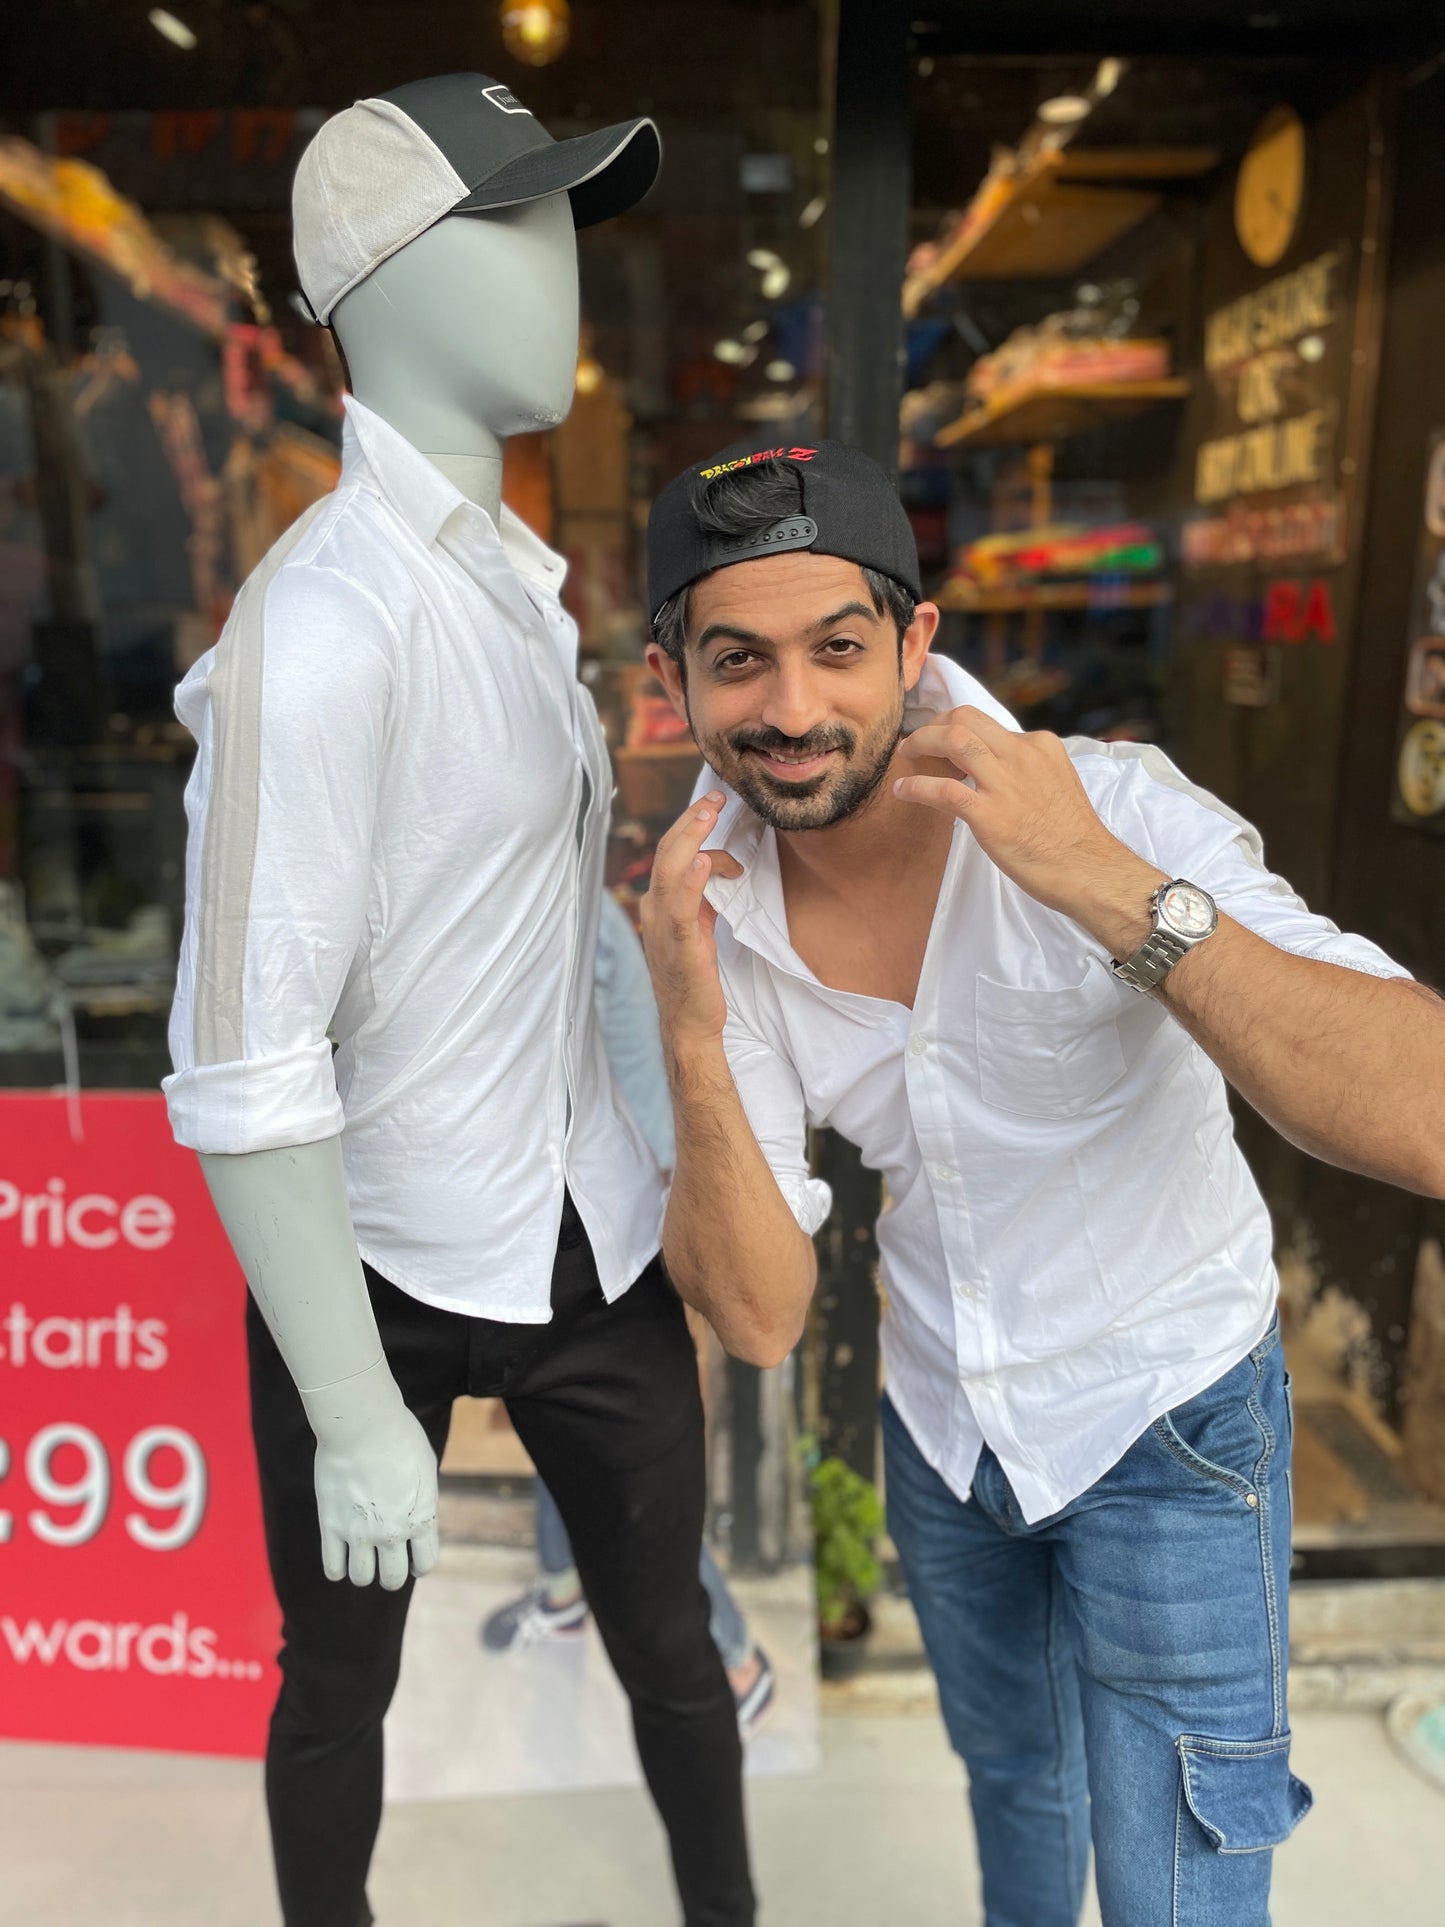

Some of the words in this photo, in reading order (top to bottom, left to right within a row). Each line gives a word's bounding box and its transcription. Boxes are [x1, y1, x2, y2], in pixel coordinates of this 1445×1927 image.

[787, 447, 819, 462] Z
[0, 1302, 169, 1370] tarts
[0, 1422, 209, 1551] 99
